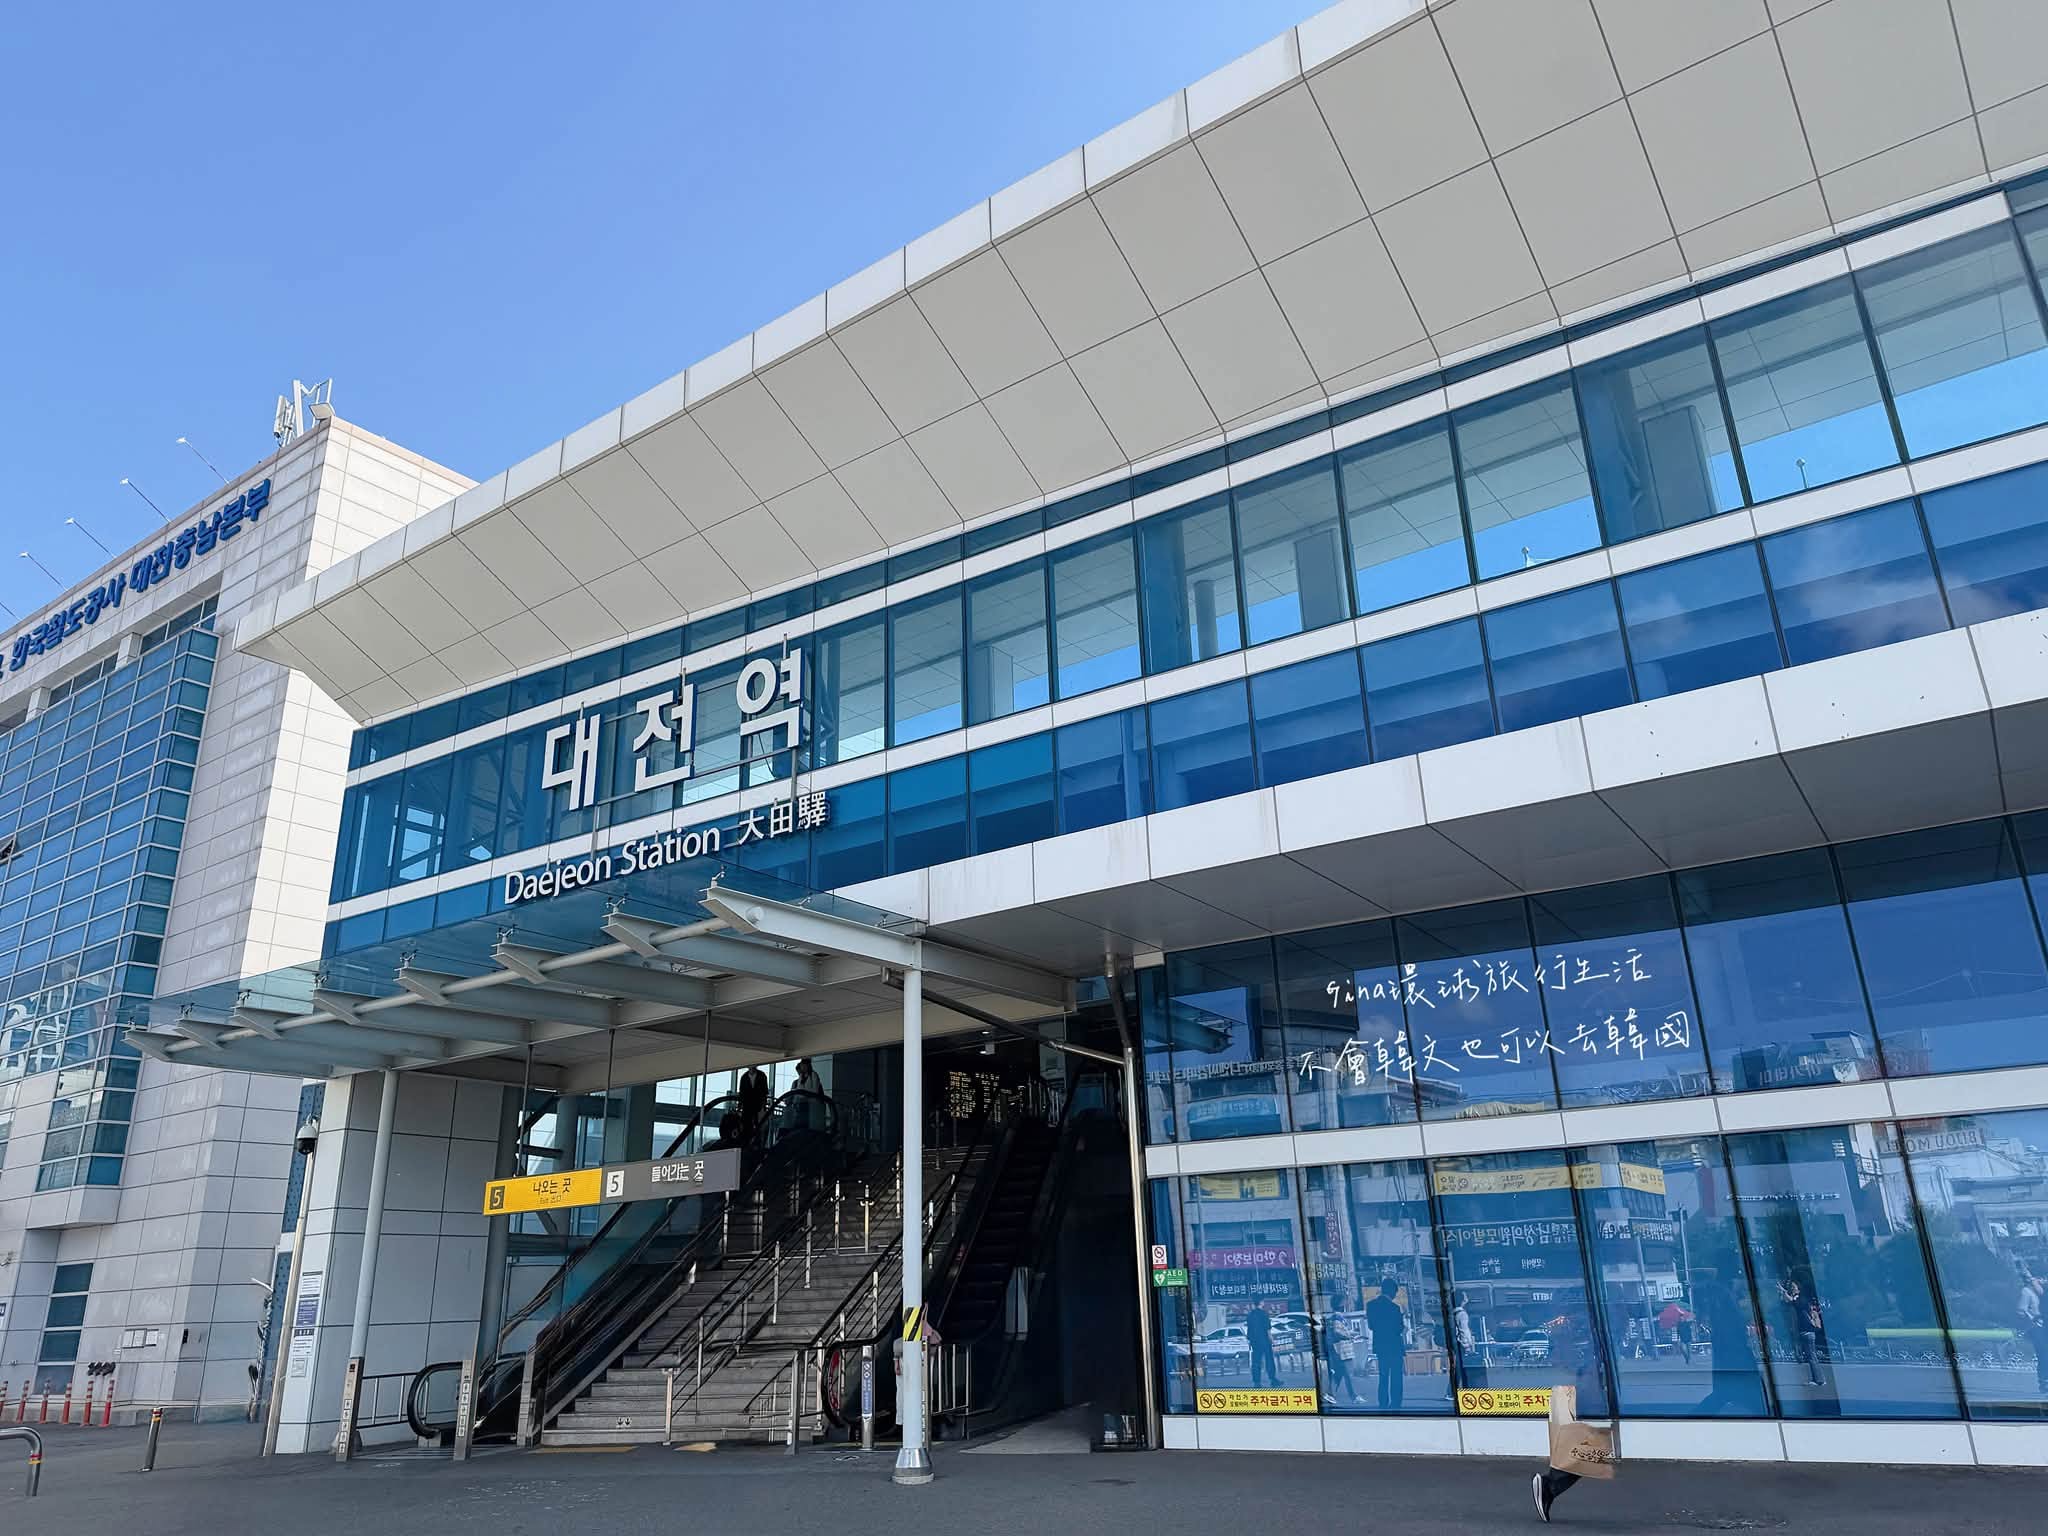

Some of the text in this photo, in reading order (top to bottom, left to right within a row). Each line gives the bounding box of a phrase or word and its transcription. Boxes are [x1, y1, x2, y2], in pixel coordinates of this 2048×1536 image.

[9, 479, 271, 671] 한국철도공사 대전충남본부
[541, 647, 805, 811] 대전역
[504, 792, 829, 905] Daejeon Station 大田驛
[491, 1177, 571, 1206] 5 나오는 곳
[610, 1160, 704, 1193] 5 들어가는 곳
[1250, 1395, 1312, 1407] 주차금지 구역
